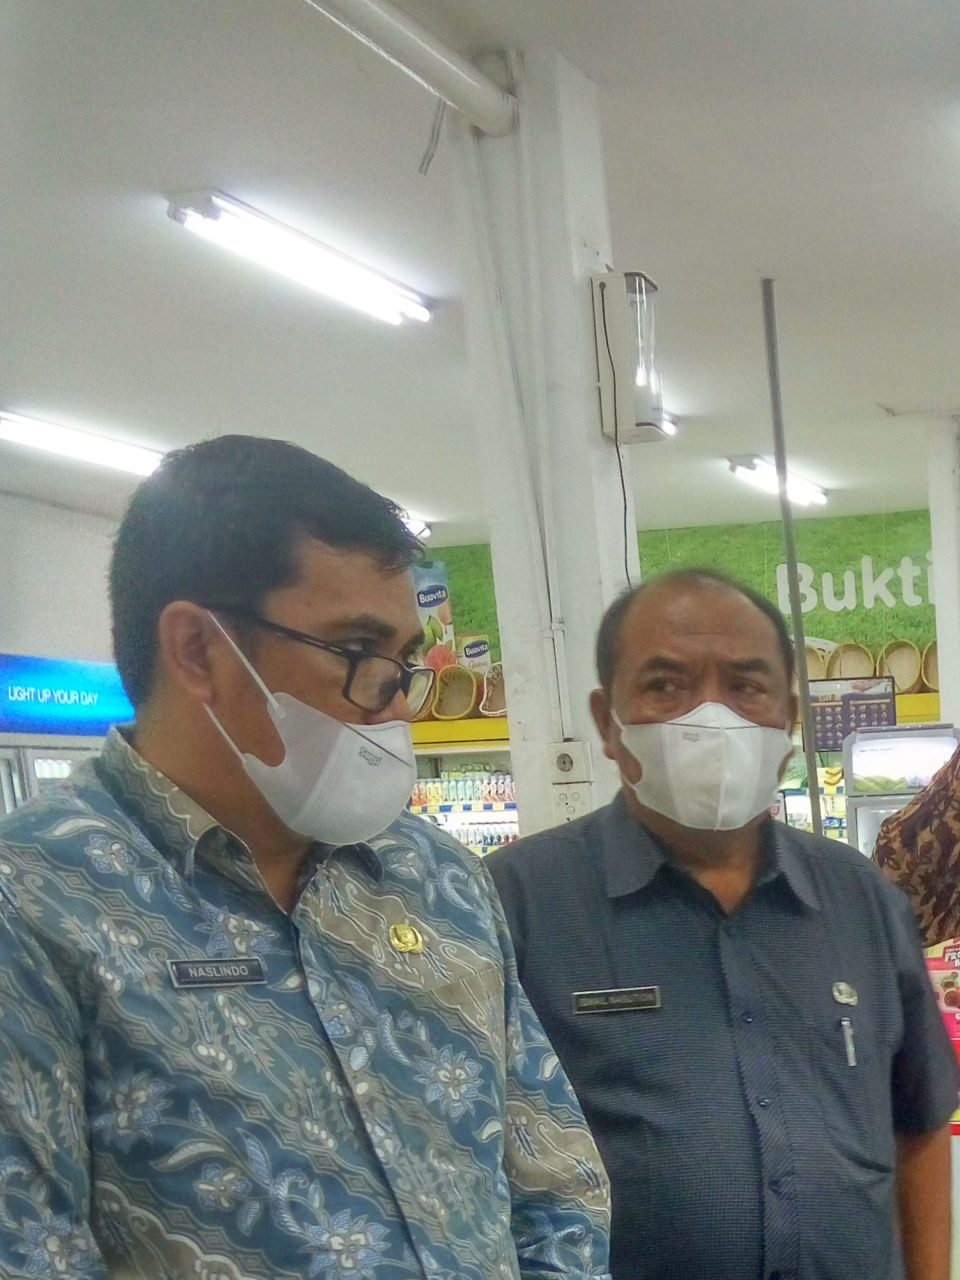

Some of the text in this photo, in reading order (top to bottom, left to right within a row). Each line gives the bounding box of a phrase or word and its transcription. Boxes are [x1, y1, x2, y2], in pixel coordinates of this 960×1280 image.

[419, 590, 447, 603] Buavita
[465, 643, 489, 656] Buavita
[8, 686, 99, 706] LIGHT UP YOUR DAY
[188, 965, 249, 977] NASLINDO
